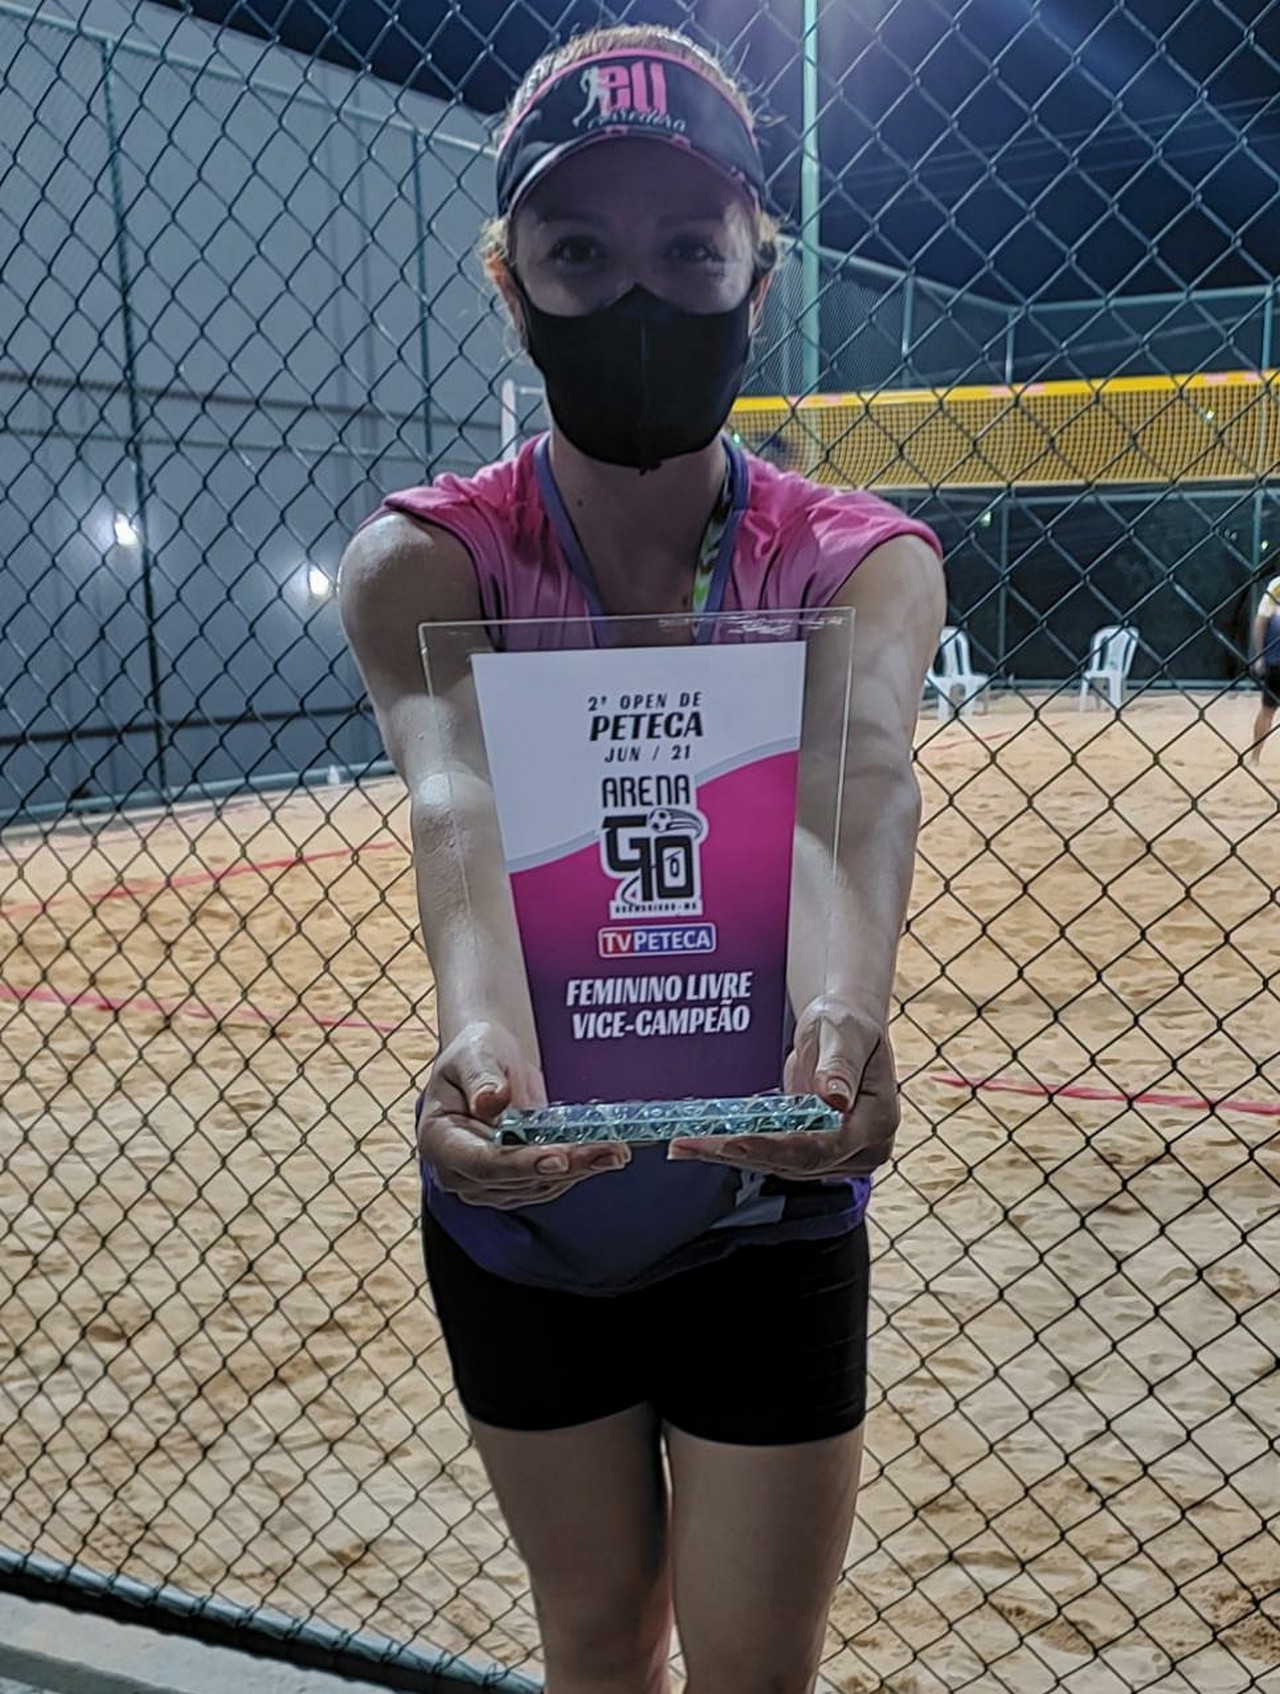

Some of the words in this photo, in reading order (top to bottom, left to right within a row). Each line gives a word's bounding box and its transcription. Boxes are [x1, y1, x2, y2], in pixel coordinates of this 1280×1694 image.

[620, 693, 668, 710] OPEN
[679, 692, 702, 708] DE
[589, 711, 703, 742] PETECA
[604, 746, 641, 763] JUN
[671, 744, 690, 761] 21
[602, 774, 690, 808] ARENA
[566, 975, 682, 1006] FEMININO
[686, 971, 753, 1001] LIVRE
[572, 999, 751, 1040] VICE-CAMPEÃO
